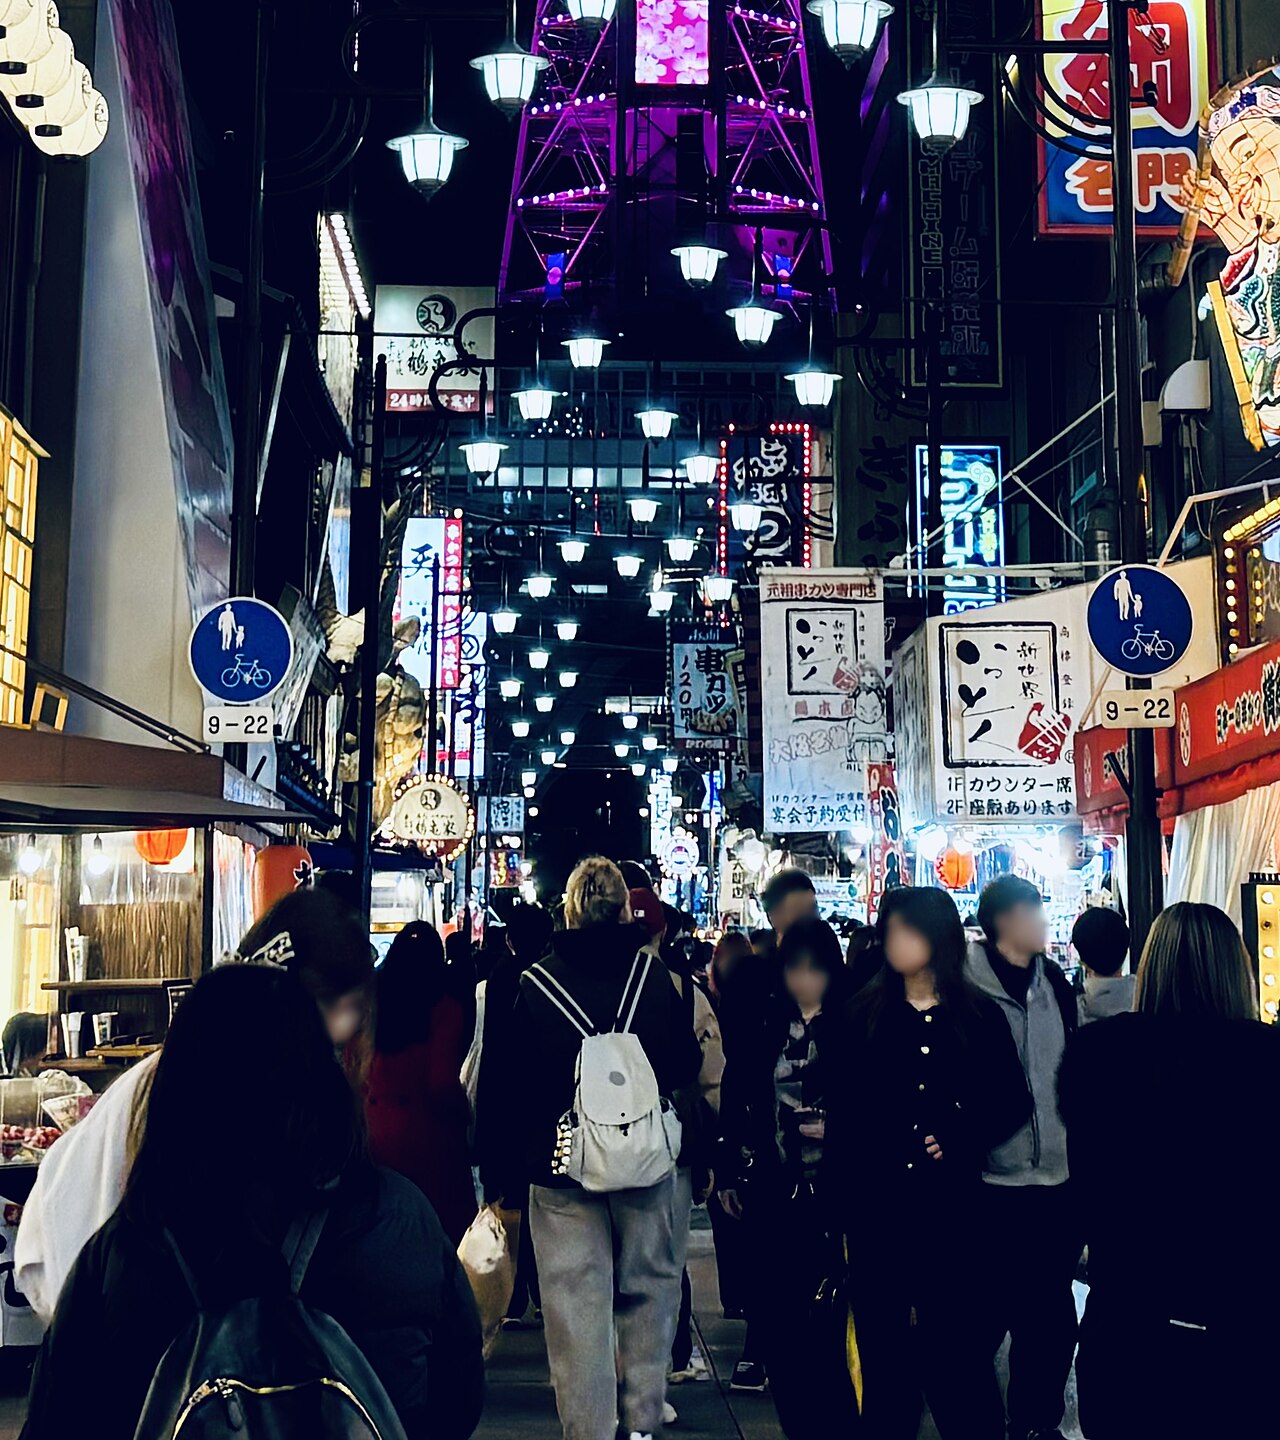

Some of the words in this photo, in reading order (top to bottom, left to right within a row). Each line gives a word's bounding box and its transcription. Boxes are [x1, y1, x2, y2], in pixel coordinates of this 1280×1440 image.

[1065, 145, 1193, 215] 名門
[766, 582, 877, 599] 元祖串カツ専門店
[695, 644, 727, 715] 串カツ
[1105, 698, 1171, 721] 9-22
[207, 713, 270, 735] 9-22
[947, 776, 964, 793] 1F
[968, 776, 1073, 794] カウンター席
[771, 804, 867, 826] 宴会予約受付
[946, 798, 964, 815] 2F
